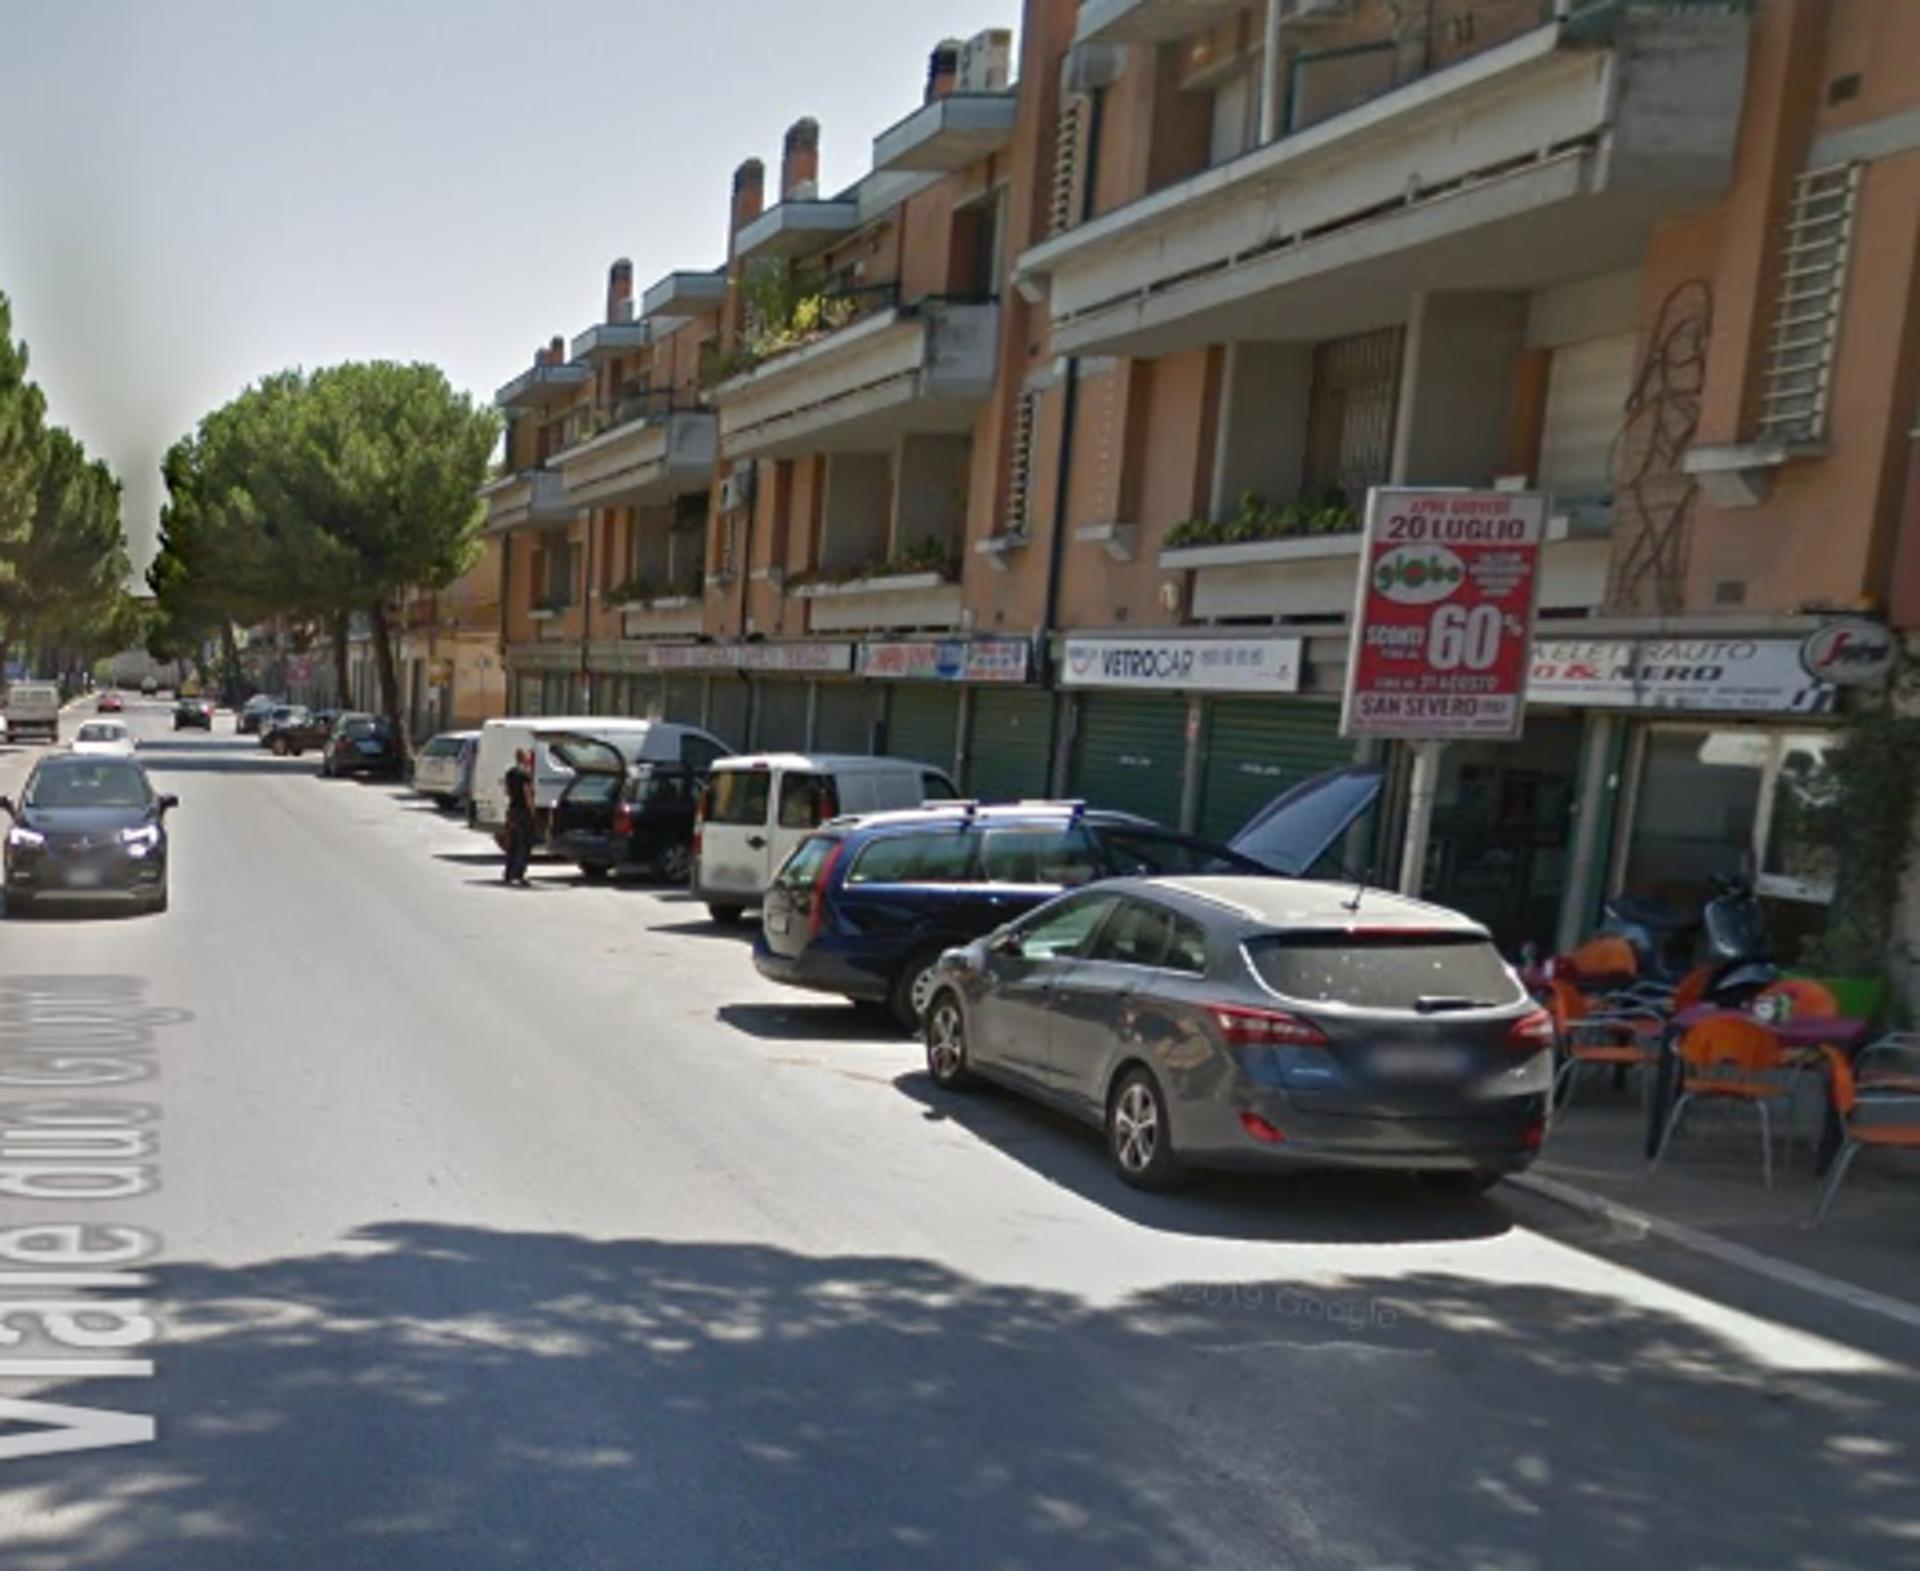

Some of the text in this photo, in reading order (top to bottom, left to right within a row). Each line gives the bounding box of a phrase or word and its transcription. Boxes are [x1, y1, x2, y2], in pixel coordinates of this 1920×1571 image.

[1388, 515, 1526, 539] 20 LUGLIO
[1103, 648, 1195, 678] VETROCAR
[1361, 696, 1400, 716] SAN
[1404, 697, 1477, 717] SEVERO
